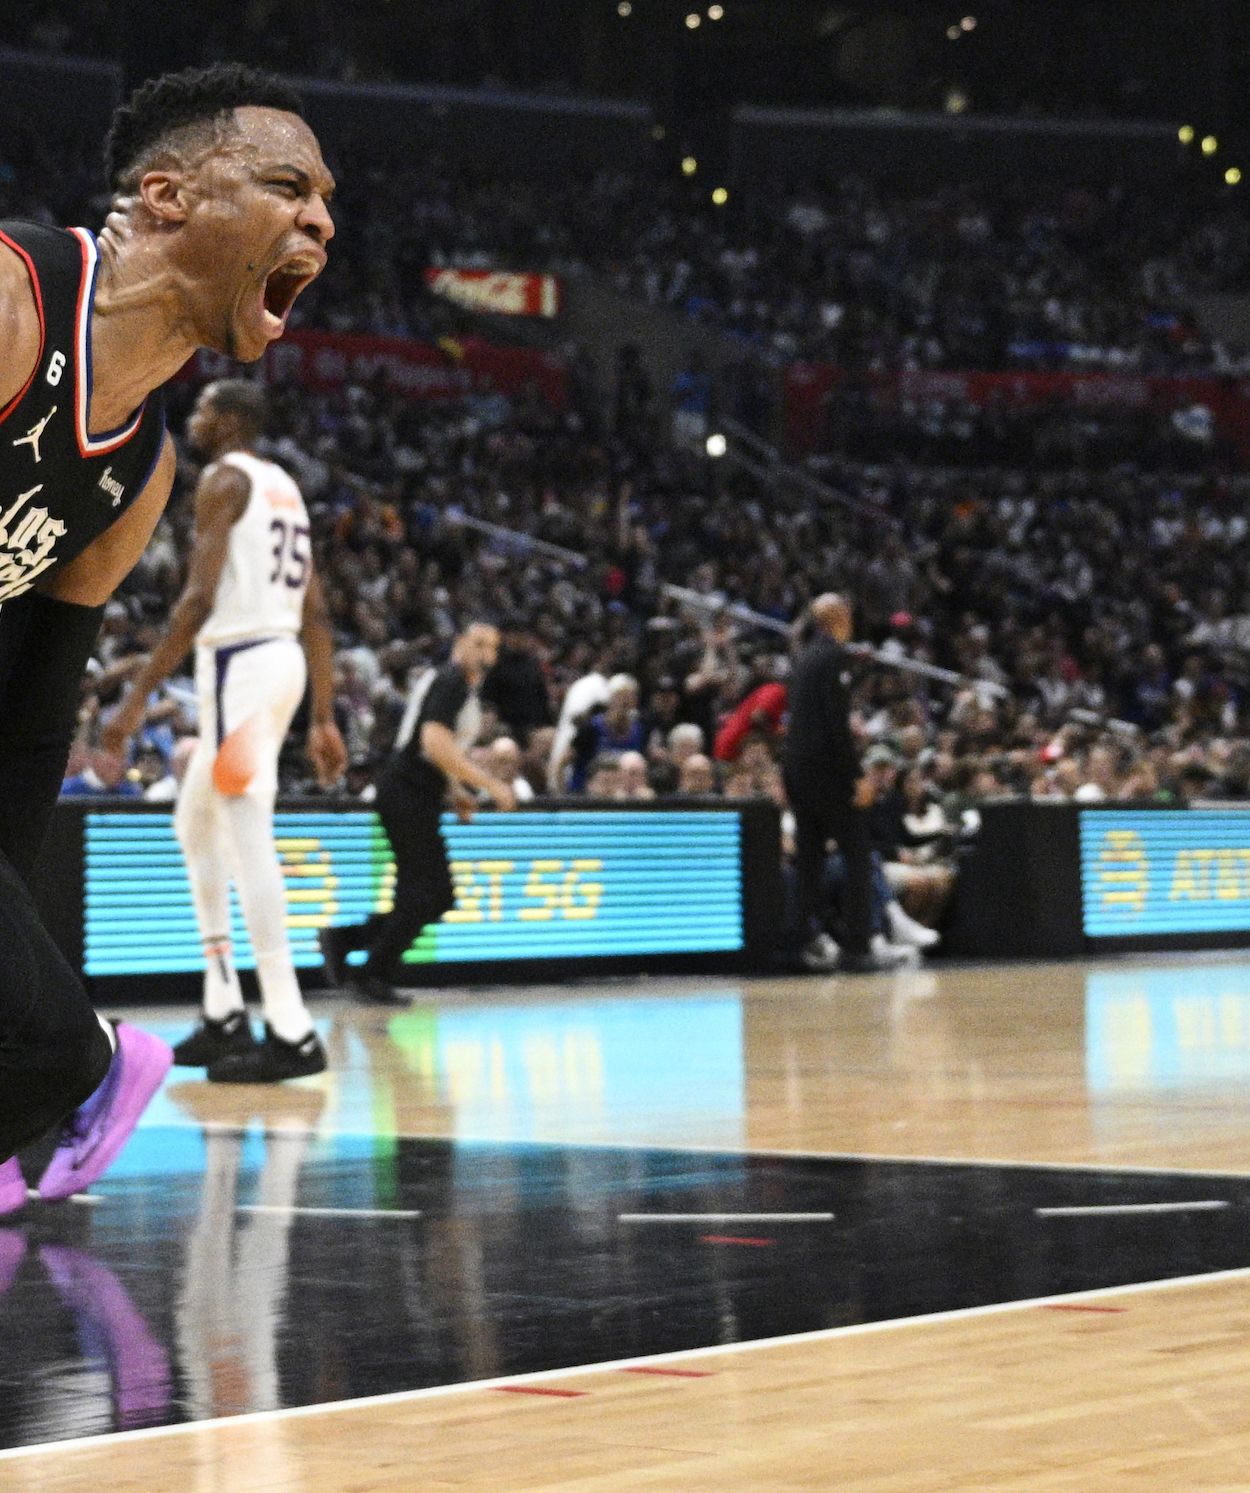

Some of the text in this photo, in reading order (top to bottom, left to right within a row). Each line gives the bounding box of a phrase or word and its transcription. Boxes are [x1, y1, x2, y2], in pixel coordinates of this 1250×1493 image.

[46, 350, 66, 387] 6
[98, 466, 125, 507] honey
[269, 517, 312, 588] 35
[518, 860, 602, 921] 5G
